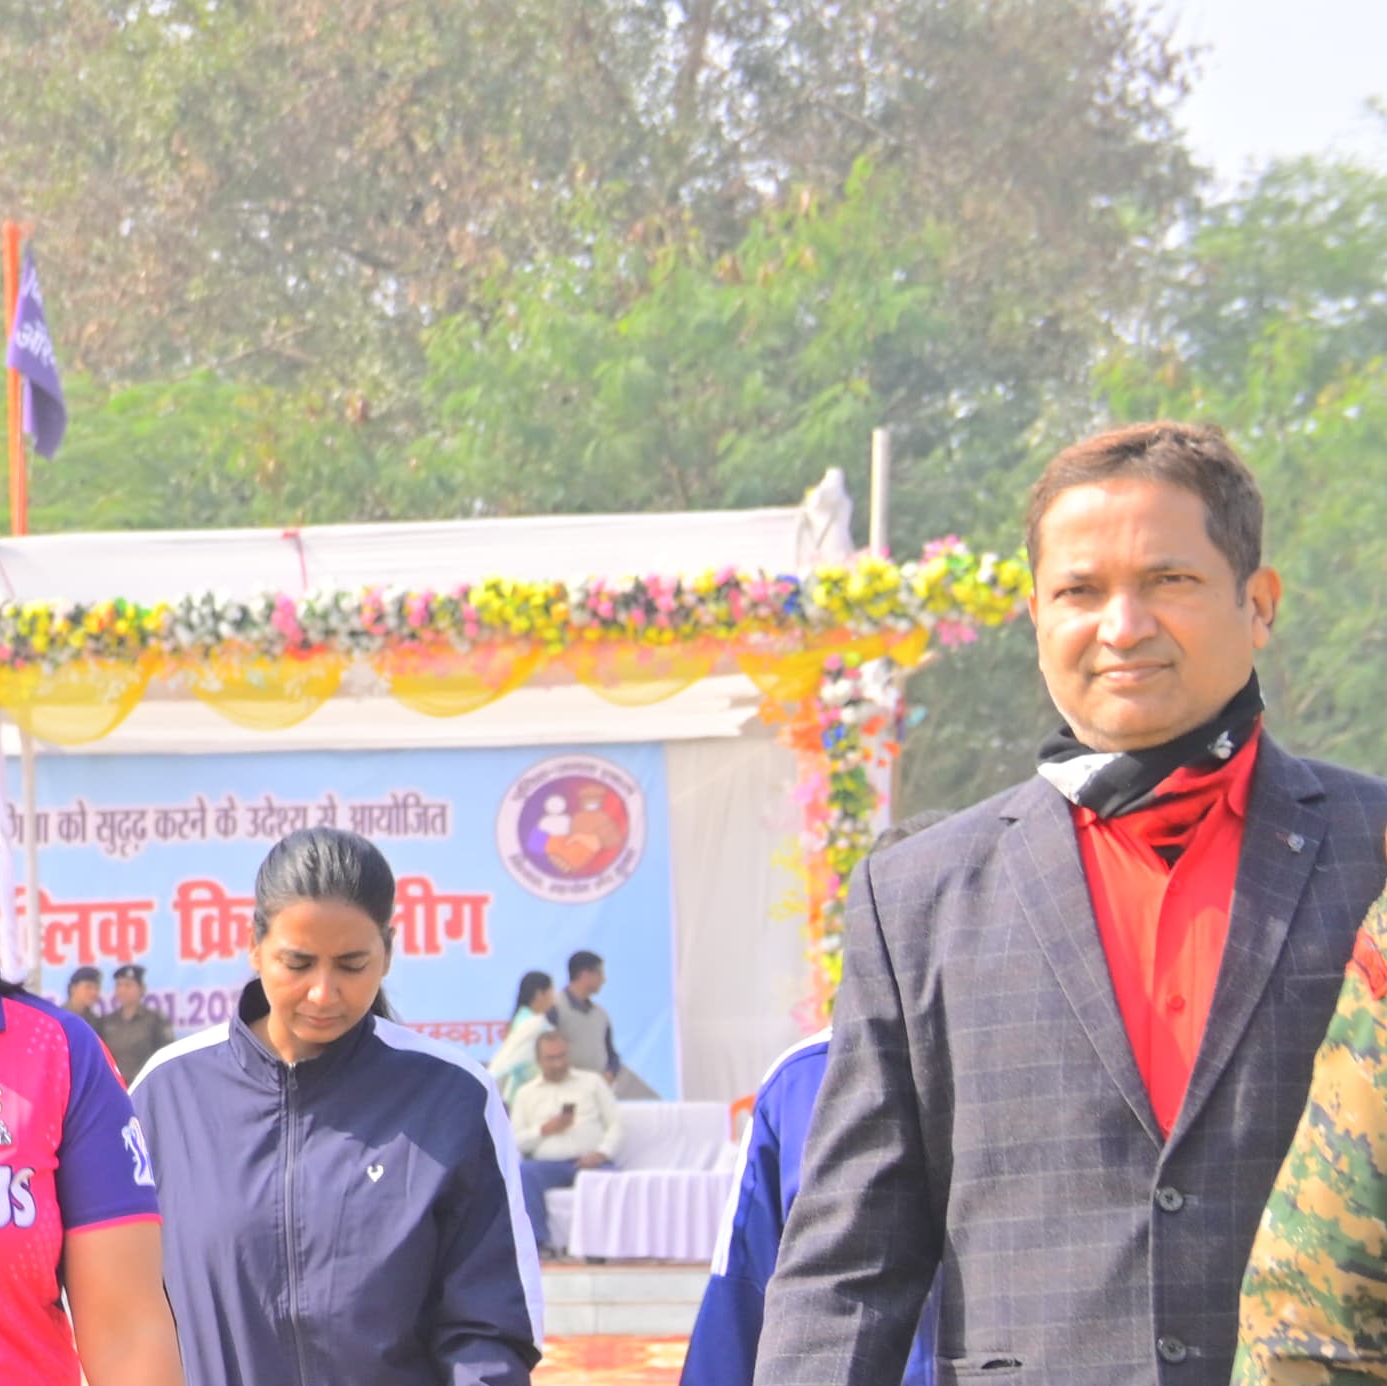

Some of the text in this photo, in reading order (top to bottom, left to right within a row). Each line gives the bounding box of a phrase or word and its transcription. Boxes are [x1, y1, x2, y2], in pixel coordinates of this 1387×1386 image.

[58, 800, 88, 842] को
[154, 796, 207, 841] करने
[215, 796, 238, 838] के
[350, 792, 448, 836] आयोजित
